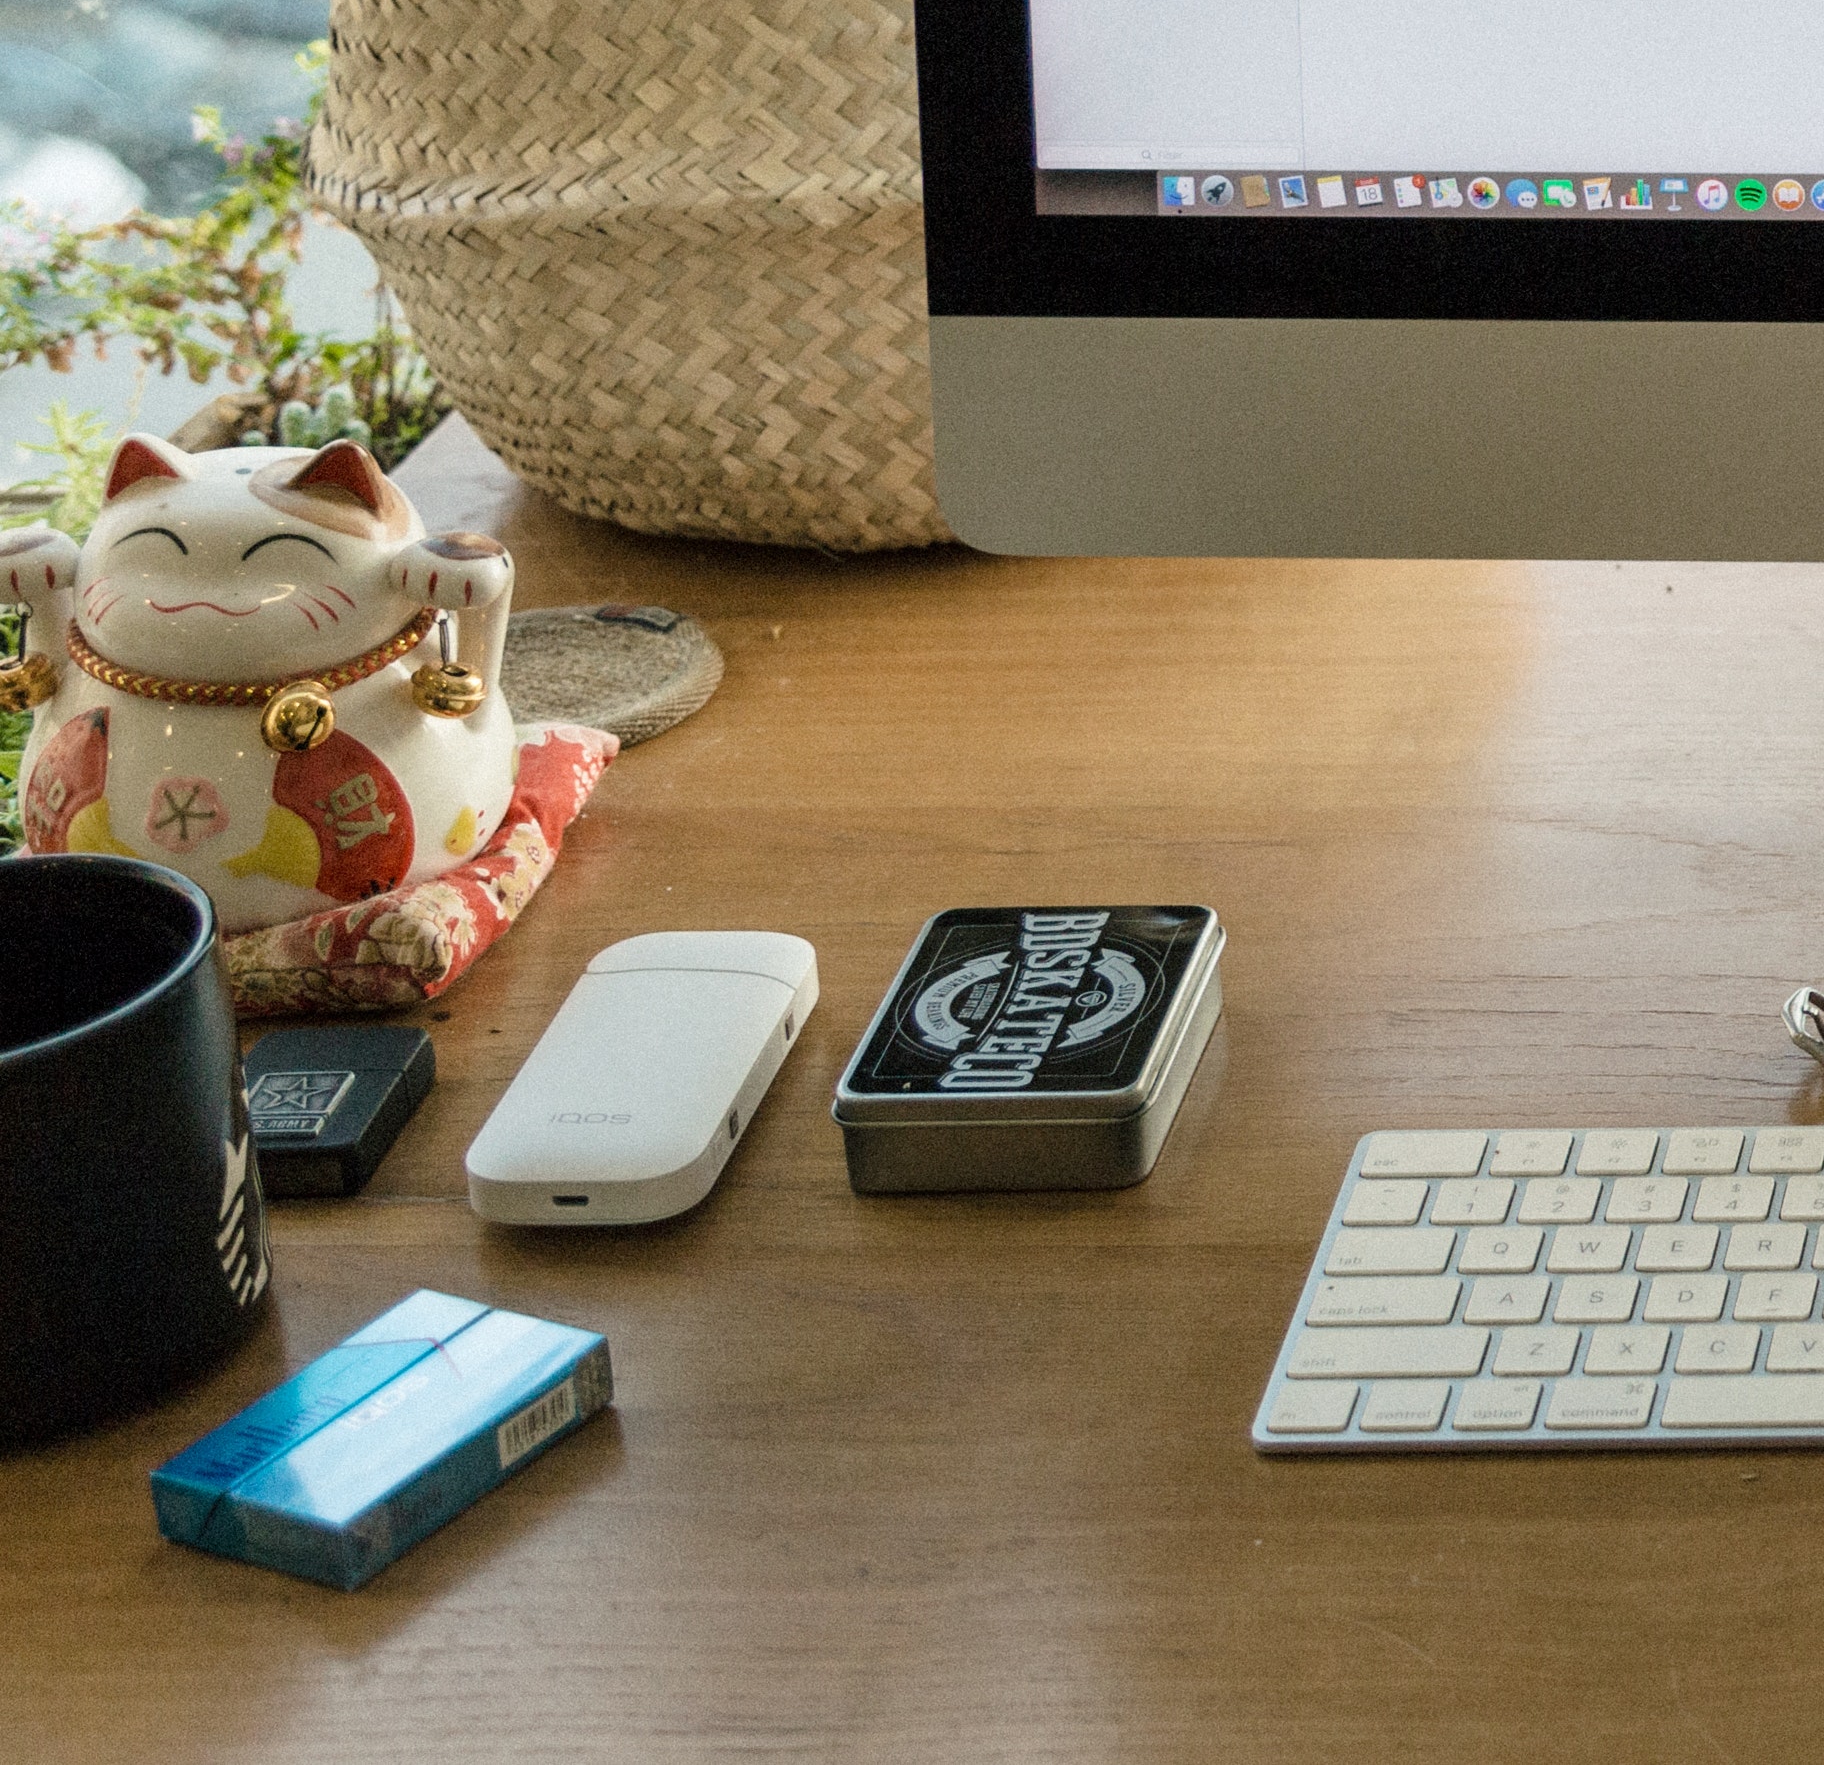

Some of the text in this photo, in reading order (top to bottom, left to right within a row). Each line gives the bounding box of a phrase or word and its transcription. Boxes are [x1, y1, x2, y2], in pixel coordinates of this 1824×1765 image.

[1361, 187, 1378, 201] 18
[933, 971, 979, 998] PREMIUM
[939, 912, 1111, 1088] BDSKATECO
[1111, 982, 1137, 1014] SILVER
[268, 1119, 311, 1129] ARMY
[1493, 1242, 1509, 1254] Q
[1580, 1242, 1600, 1253] W
[1671, 1241, 1683, 1252] E
[1758, 1240, 1772, 1251] R
